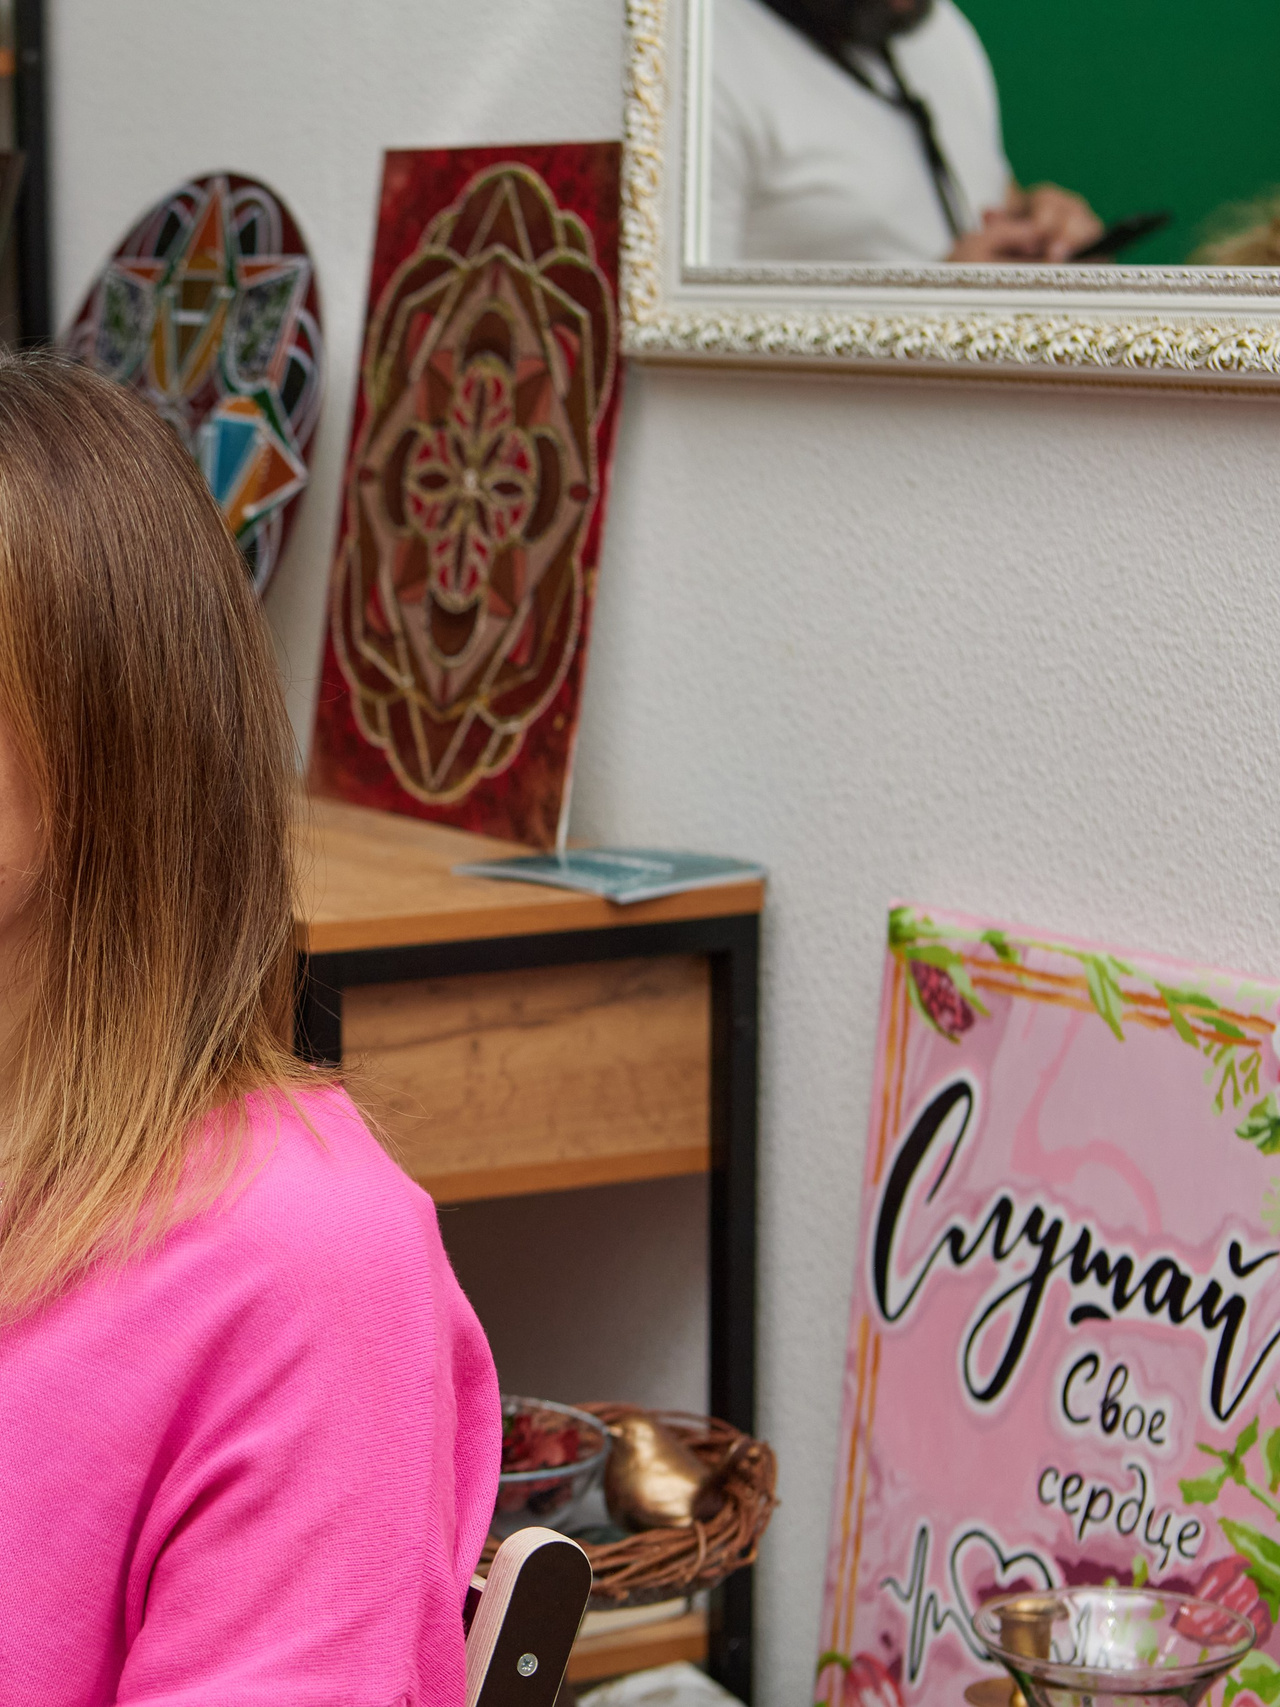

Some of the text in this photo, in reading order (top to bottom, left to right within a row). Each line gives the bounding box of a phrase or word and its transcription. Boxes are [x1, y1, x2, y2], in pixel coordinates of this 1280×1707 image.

[873, 1079, 1280, 1421] Слушай
[1062, 1352, 1166, 1445] Свое
[1038, 1465, 1201, 1571] сердце
